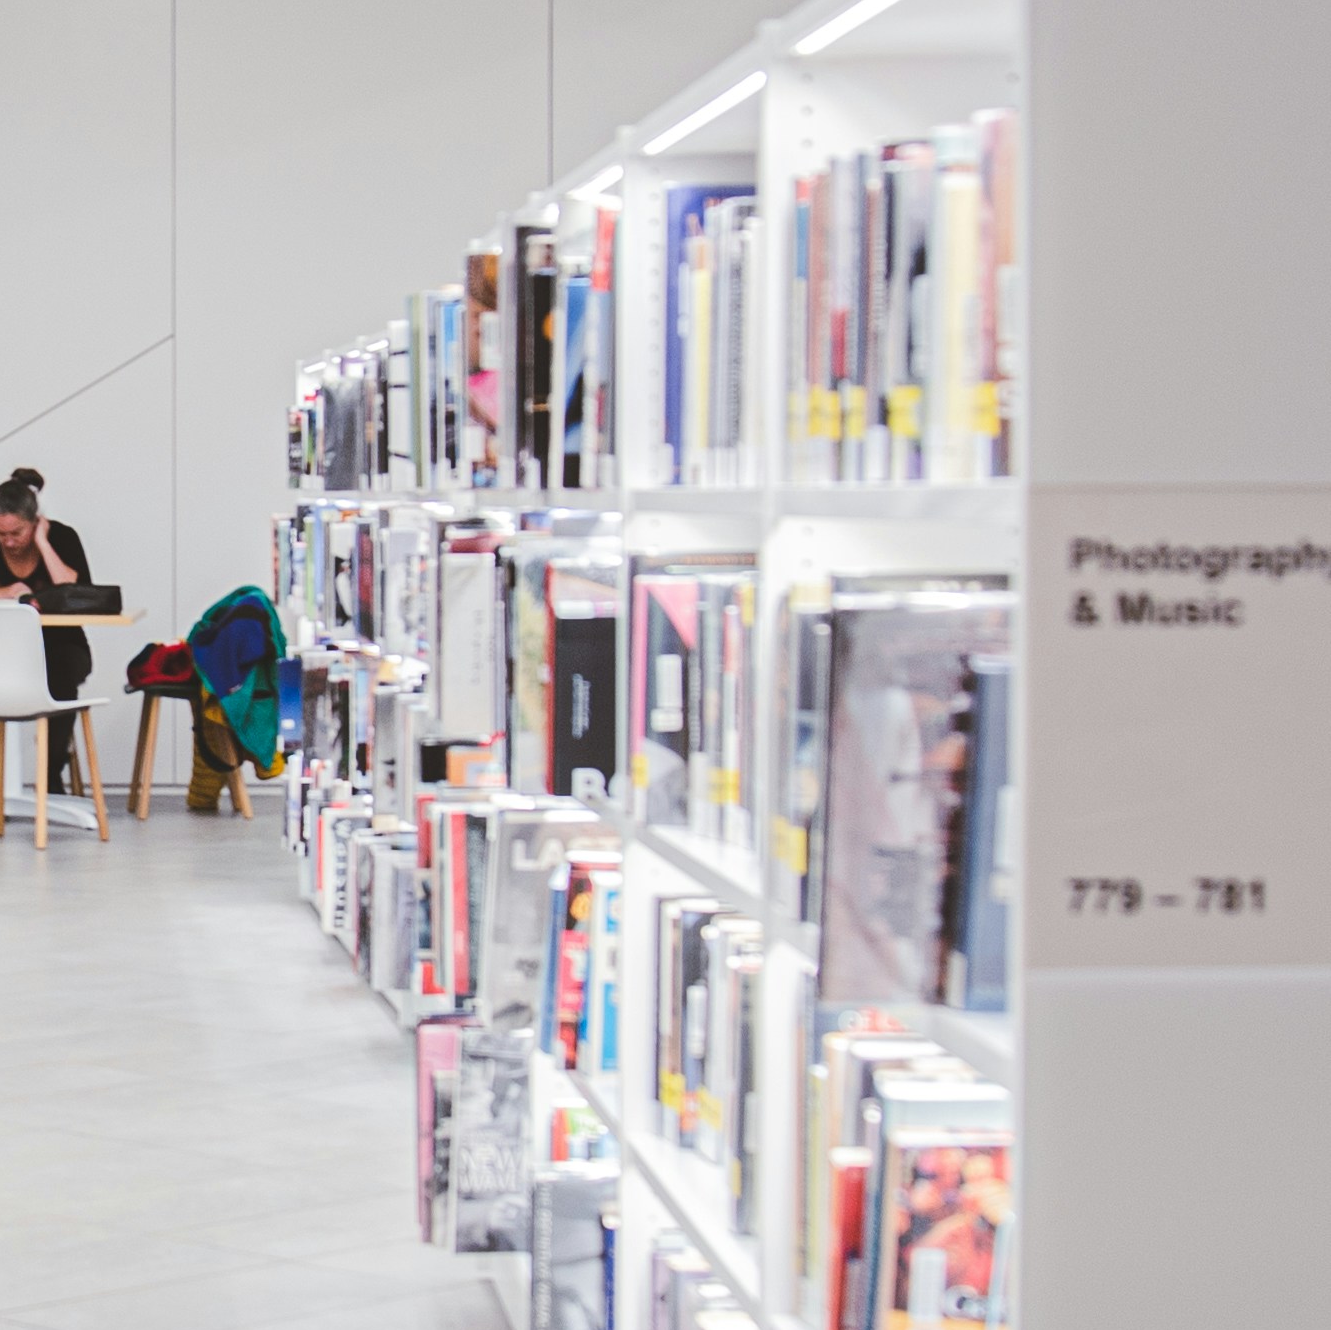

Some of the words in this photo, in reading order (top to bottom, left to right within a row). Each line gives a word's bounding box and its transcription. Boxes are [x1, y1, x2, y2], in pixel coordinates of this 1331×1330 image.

[1070, 537, 1331, 579] Photograph
[1073, 593, 1098, 625] &
[1116, 593, 1244, 626] Music
[1069, 878, 1143, 916] 779
[1196, 878, 1265, 916] 781
